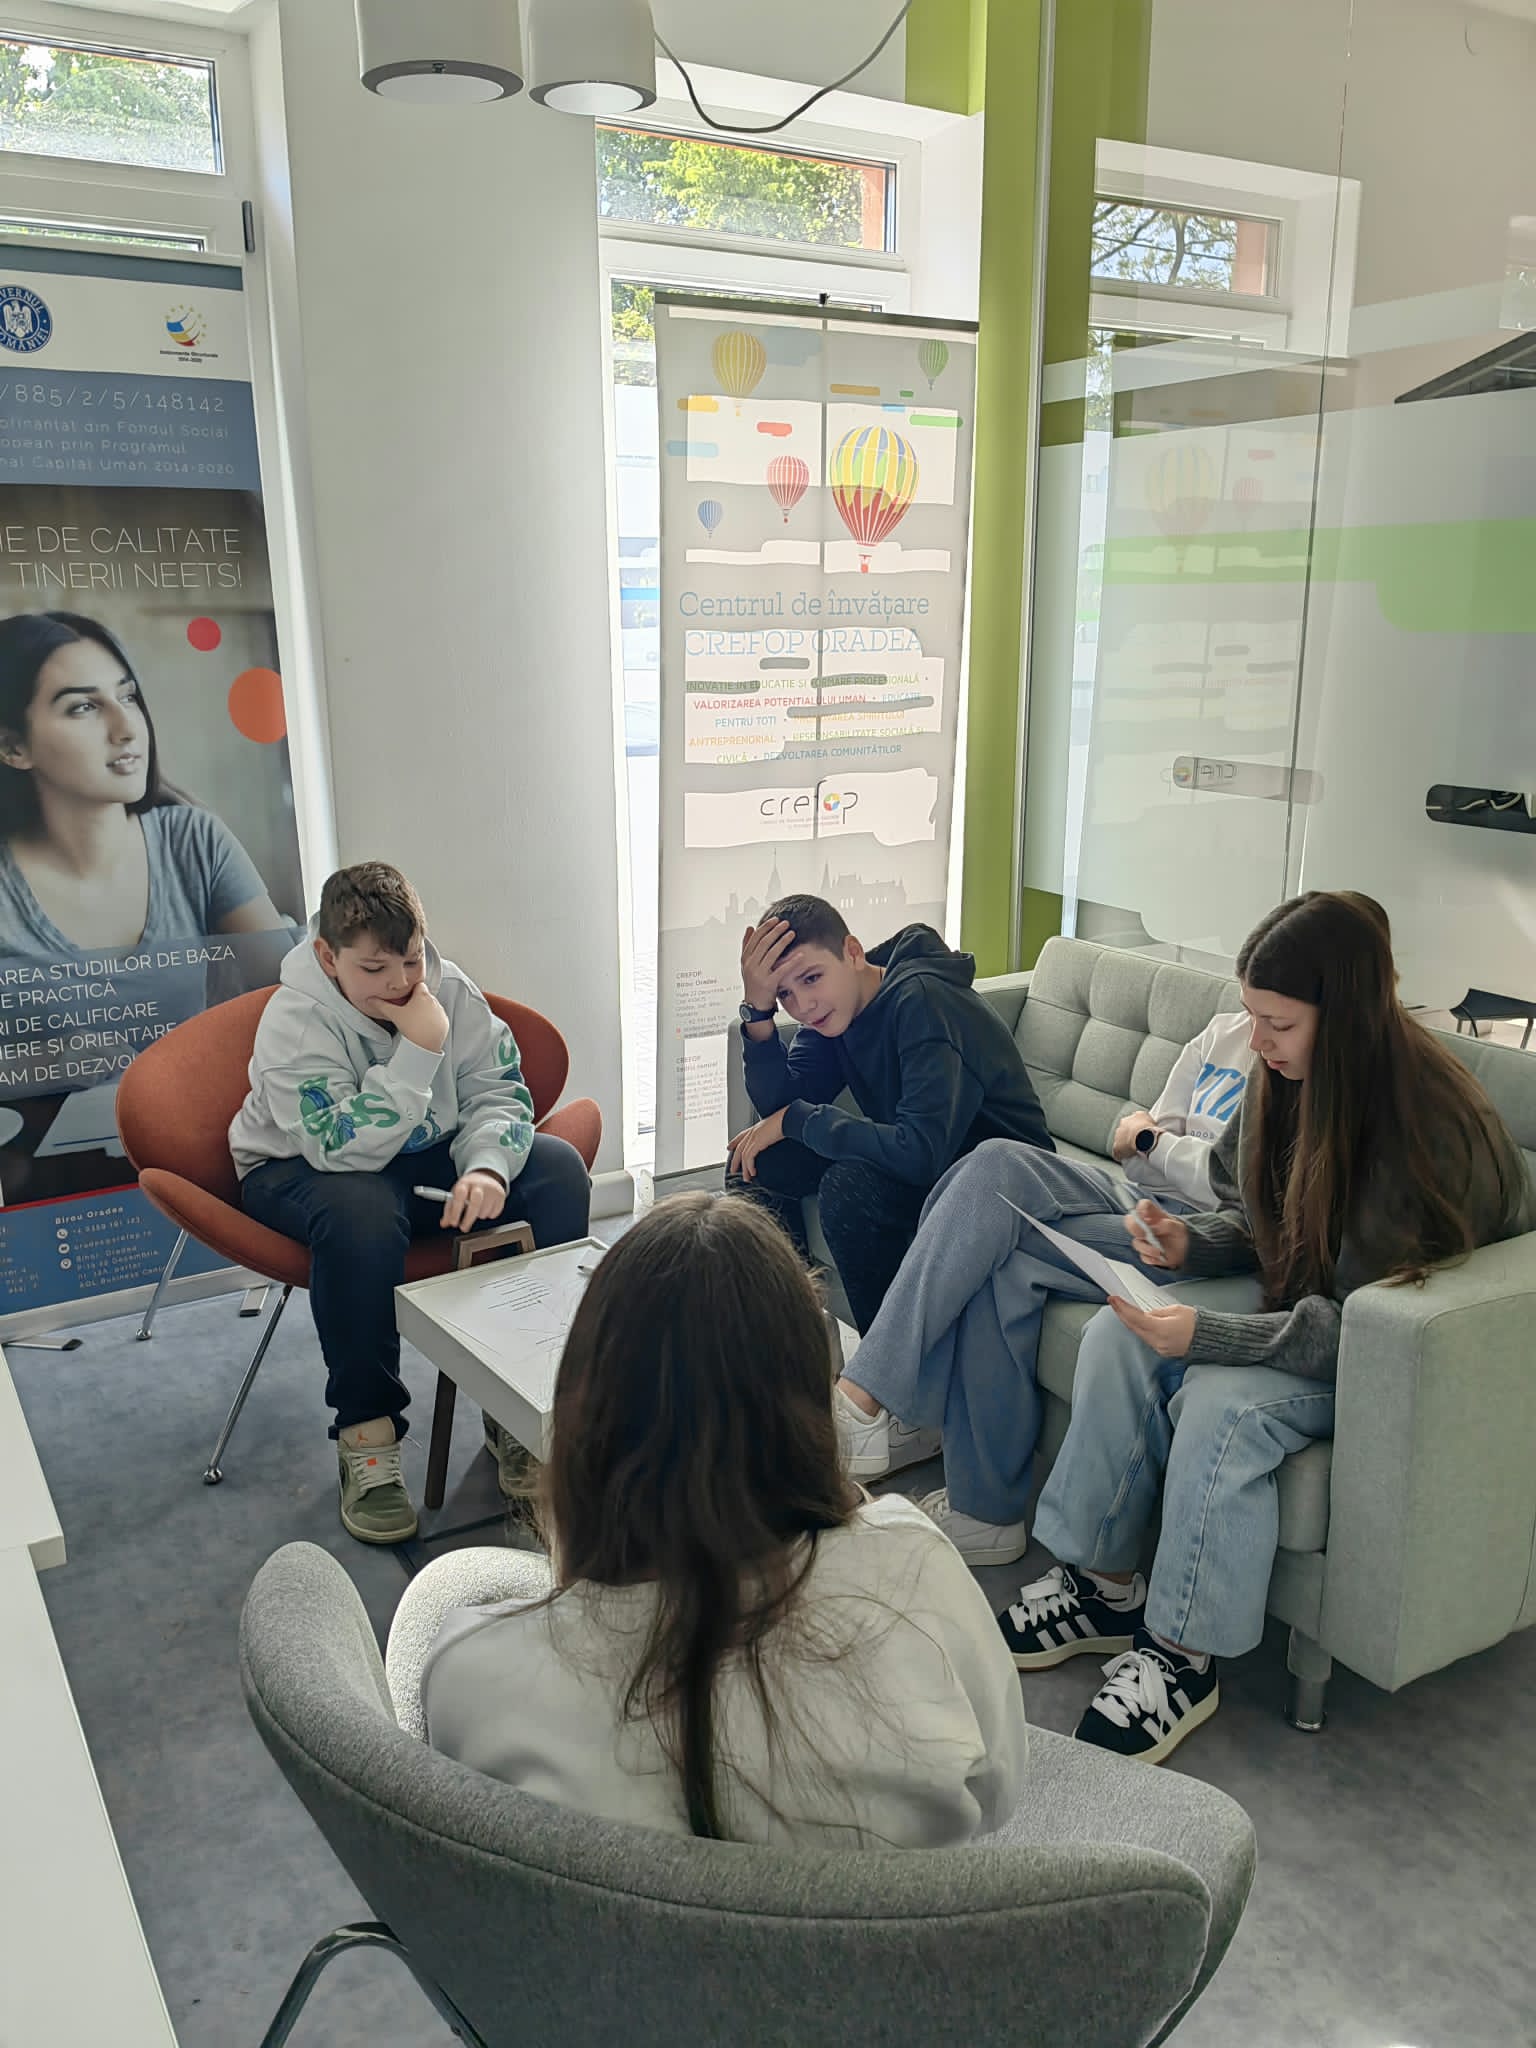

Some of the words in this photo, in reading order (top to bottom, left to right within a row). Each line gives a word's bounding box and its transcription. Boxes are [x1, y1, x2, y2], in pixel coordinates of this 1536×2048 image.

[36, 526, 82, 553] DE
[90, 526, 241, 554] CALITATE
[8, 561, 126, 589] TINERII
[134, 561, 243, 589] NEETS!
[678, 590, 785, 617] Centrul
[791, 591, 823, 616] de
[827, 589, 930, 624] învățare
[685, 630, 804, 656] CREFOP
[811, 628, 921, 653] ORADEA
[694, 698, 761, 710] VALORIZAREA
[714, 718, 754, 729] PENTRU
[689, 735, 777, 748] ANTREPRENORIAL
[50, 956, 152, 980] STUDIILOR
[156, 951, 182, 968] DE
[186, 945, 236, 964] BAZA
[18, 978, 118, 1008] PRACTICĂ
[15, 1015, 43, 1034] DE
[47, 1000, 160, 1029] CALIFICARE
[34, 1064, 62, 1082] DE
[66, 1053, 137, 1078] DEZVO
[55, 1214, 83, 1225] Birou
